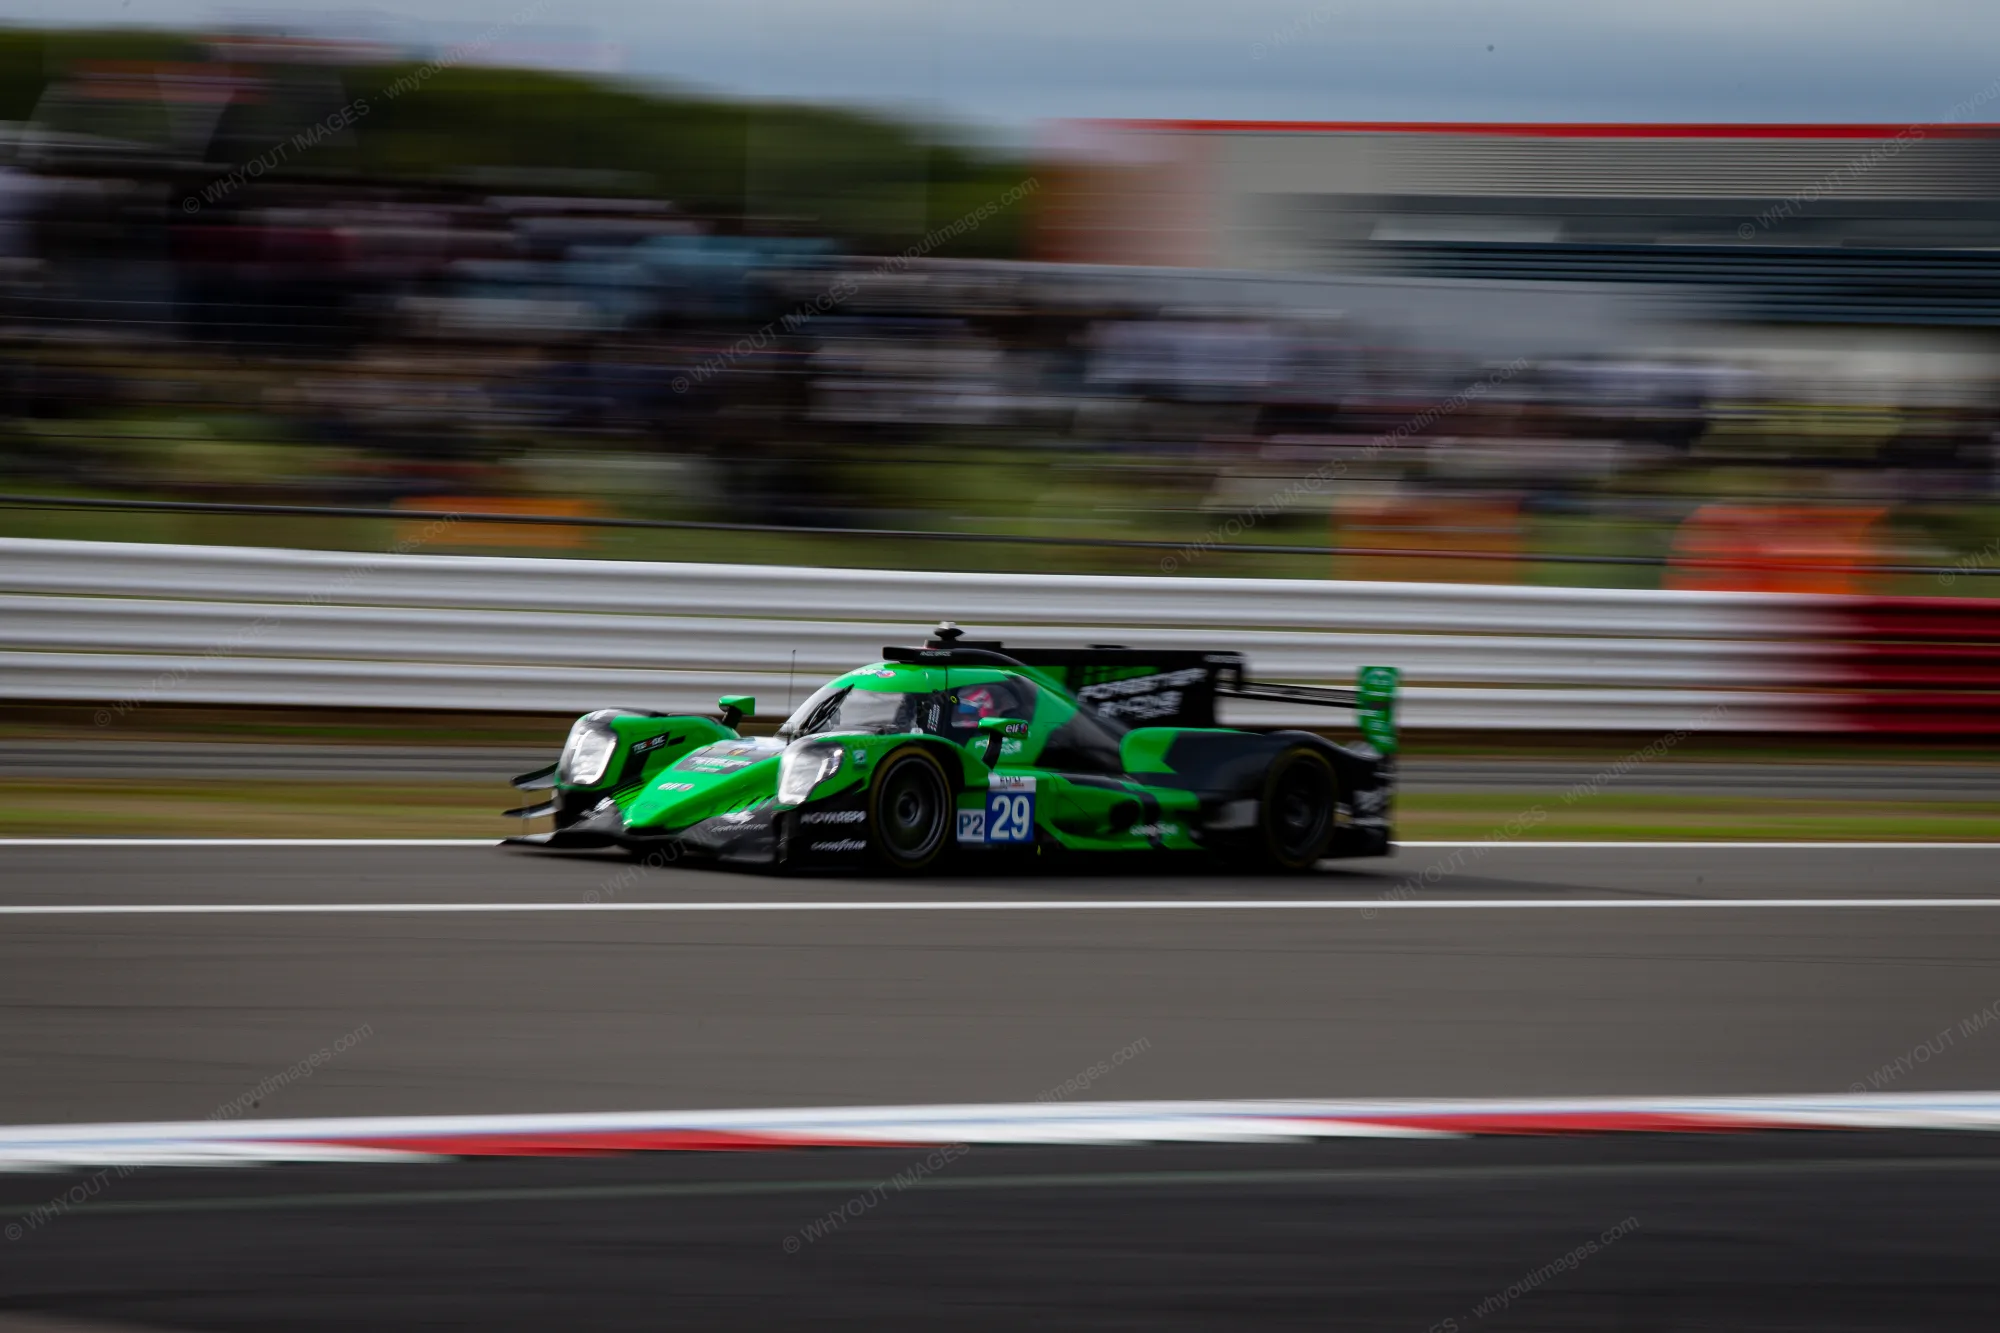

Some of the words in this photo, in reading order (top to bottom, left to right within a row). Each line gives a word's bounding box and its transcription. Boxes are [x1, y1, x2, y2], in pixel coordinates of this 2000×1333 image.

[1005, 724, 1020, 733] elf
[958, 814, 984, 836] P2
[990, 795, 1031, 841] 29
